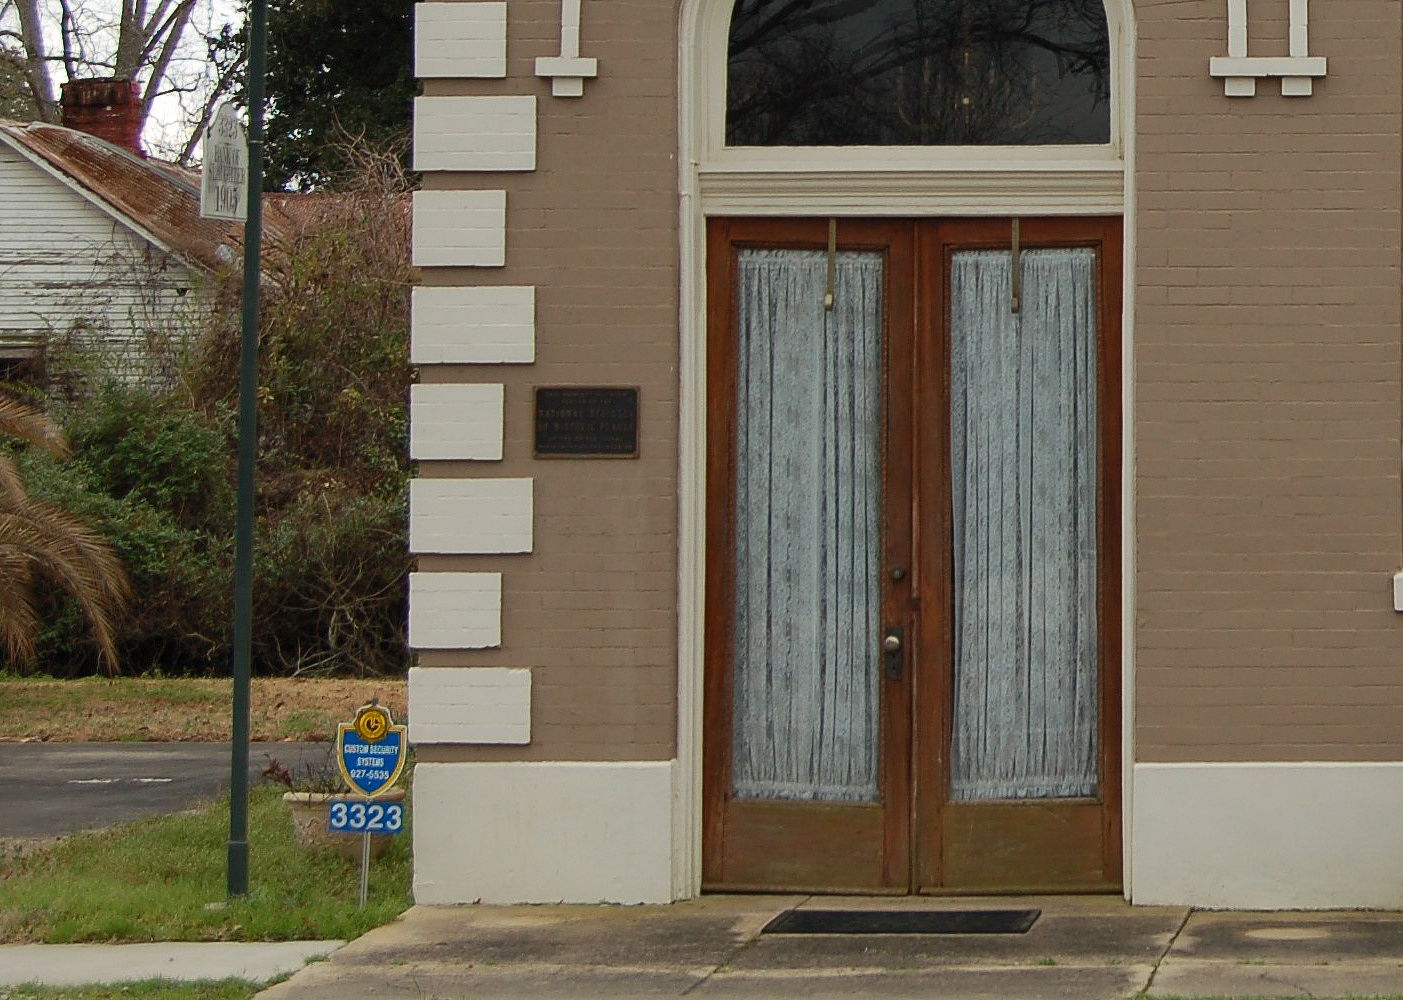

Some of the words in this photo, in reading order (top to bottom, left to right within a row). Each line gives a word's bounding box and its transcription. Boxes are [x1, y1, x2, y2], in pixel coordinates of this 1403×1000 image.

[214, 185, 239, 215] 1905
[344, 744, 369, 754] CUSTOM
[370, 745, 399, 755] SECURITY
[357, 757, 383, 767] SYSTEMS
[331, 803, 402, 830] 3323
